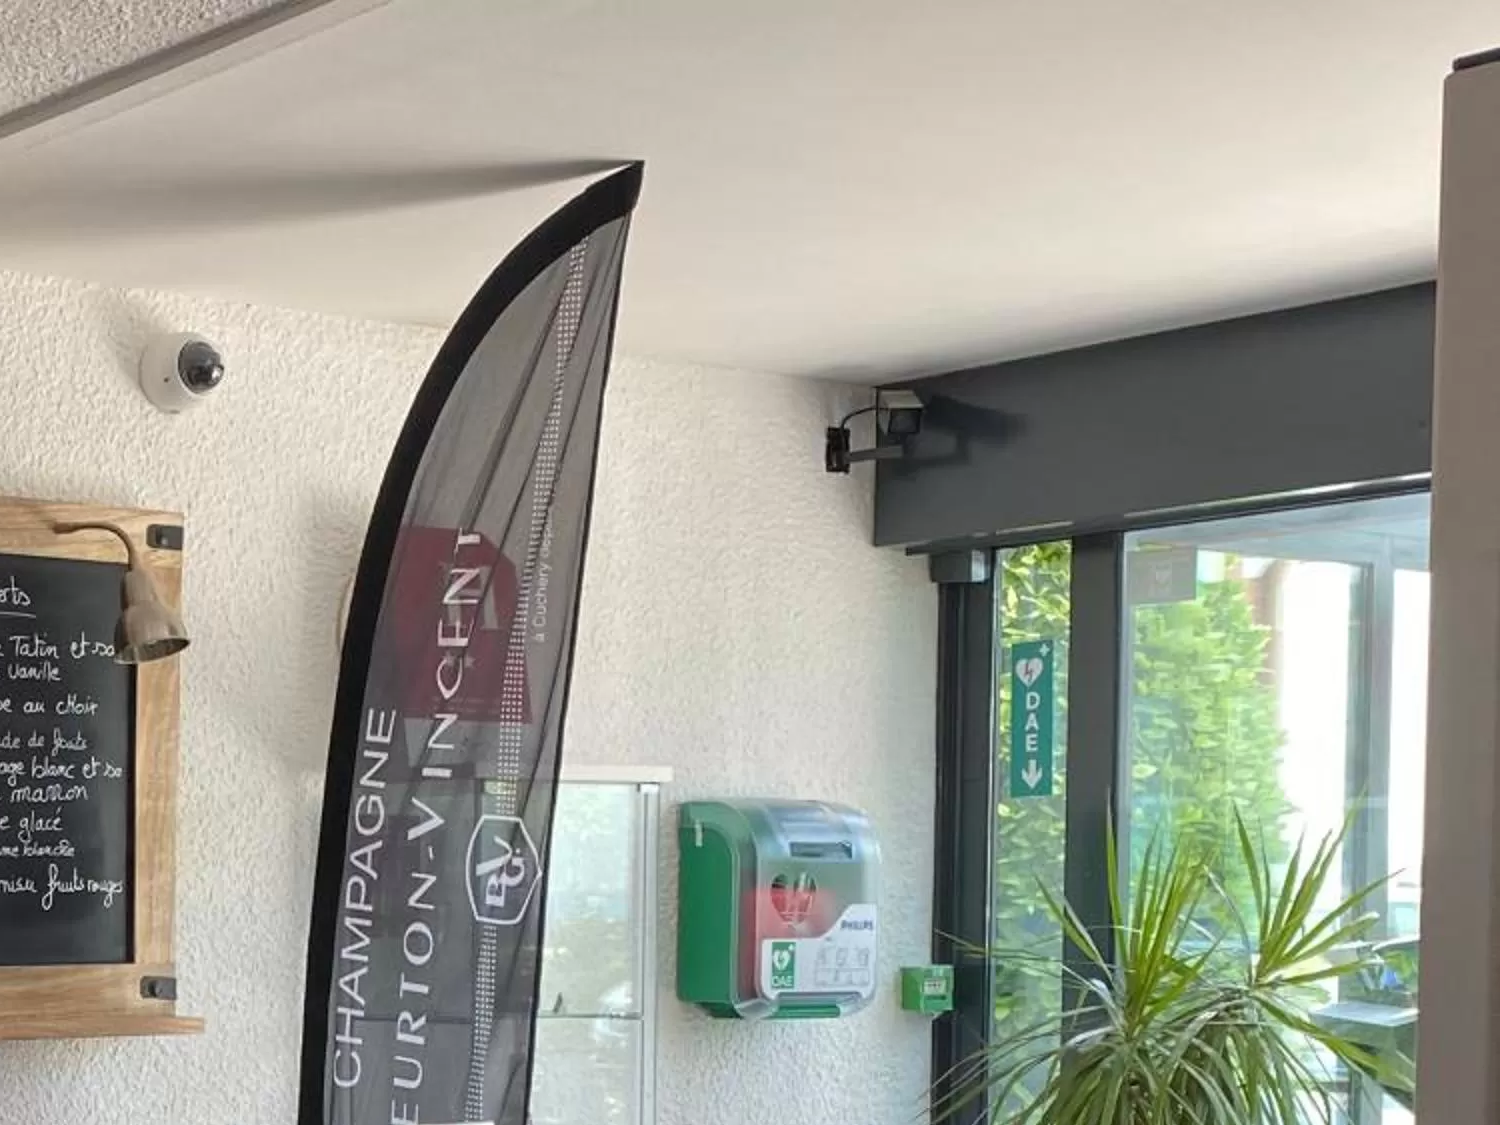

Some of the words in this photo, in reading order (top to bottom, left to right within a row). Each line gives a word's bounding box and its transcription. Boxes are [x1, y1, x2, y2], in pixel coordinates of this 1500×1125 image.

[9, 632, 60, 659] Tatin
[70, 631, 92, 659] et
[23, 701, 45, 714] au
[1025, 692, 1041, 752] DAE
[28, 731, 45, 747] de
[31, 756, 75, 778] blanc
[83, 756, 102, 778] et
[334, 708, 396, 1089] CHAMPAGNE
[771, 975, 794, 988] DAE
